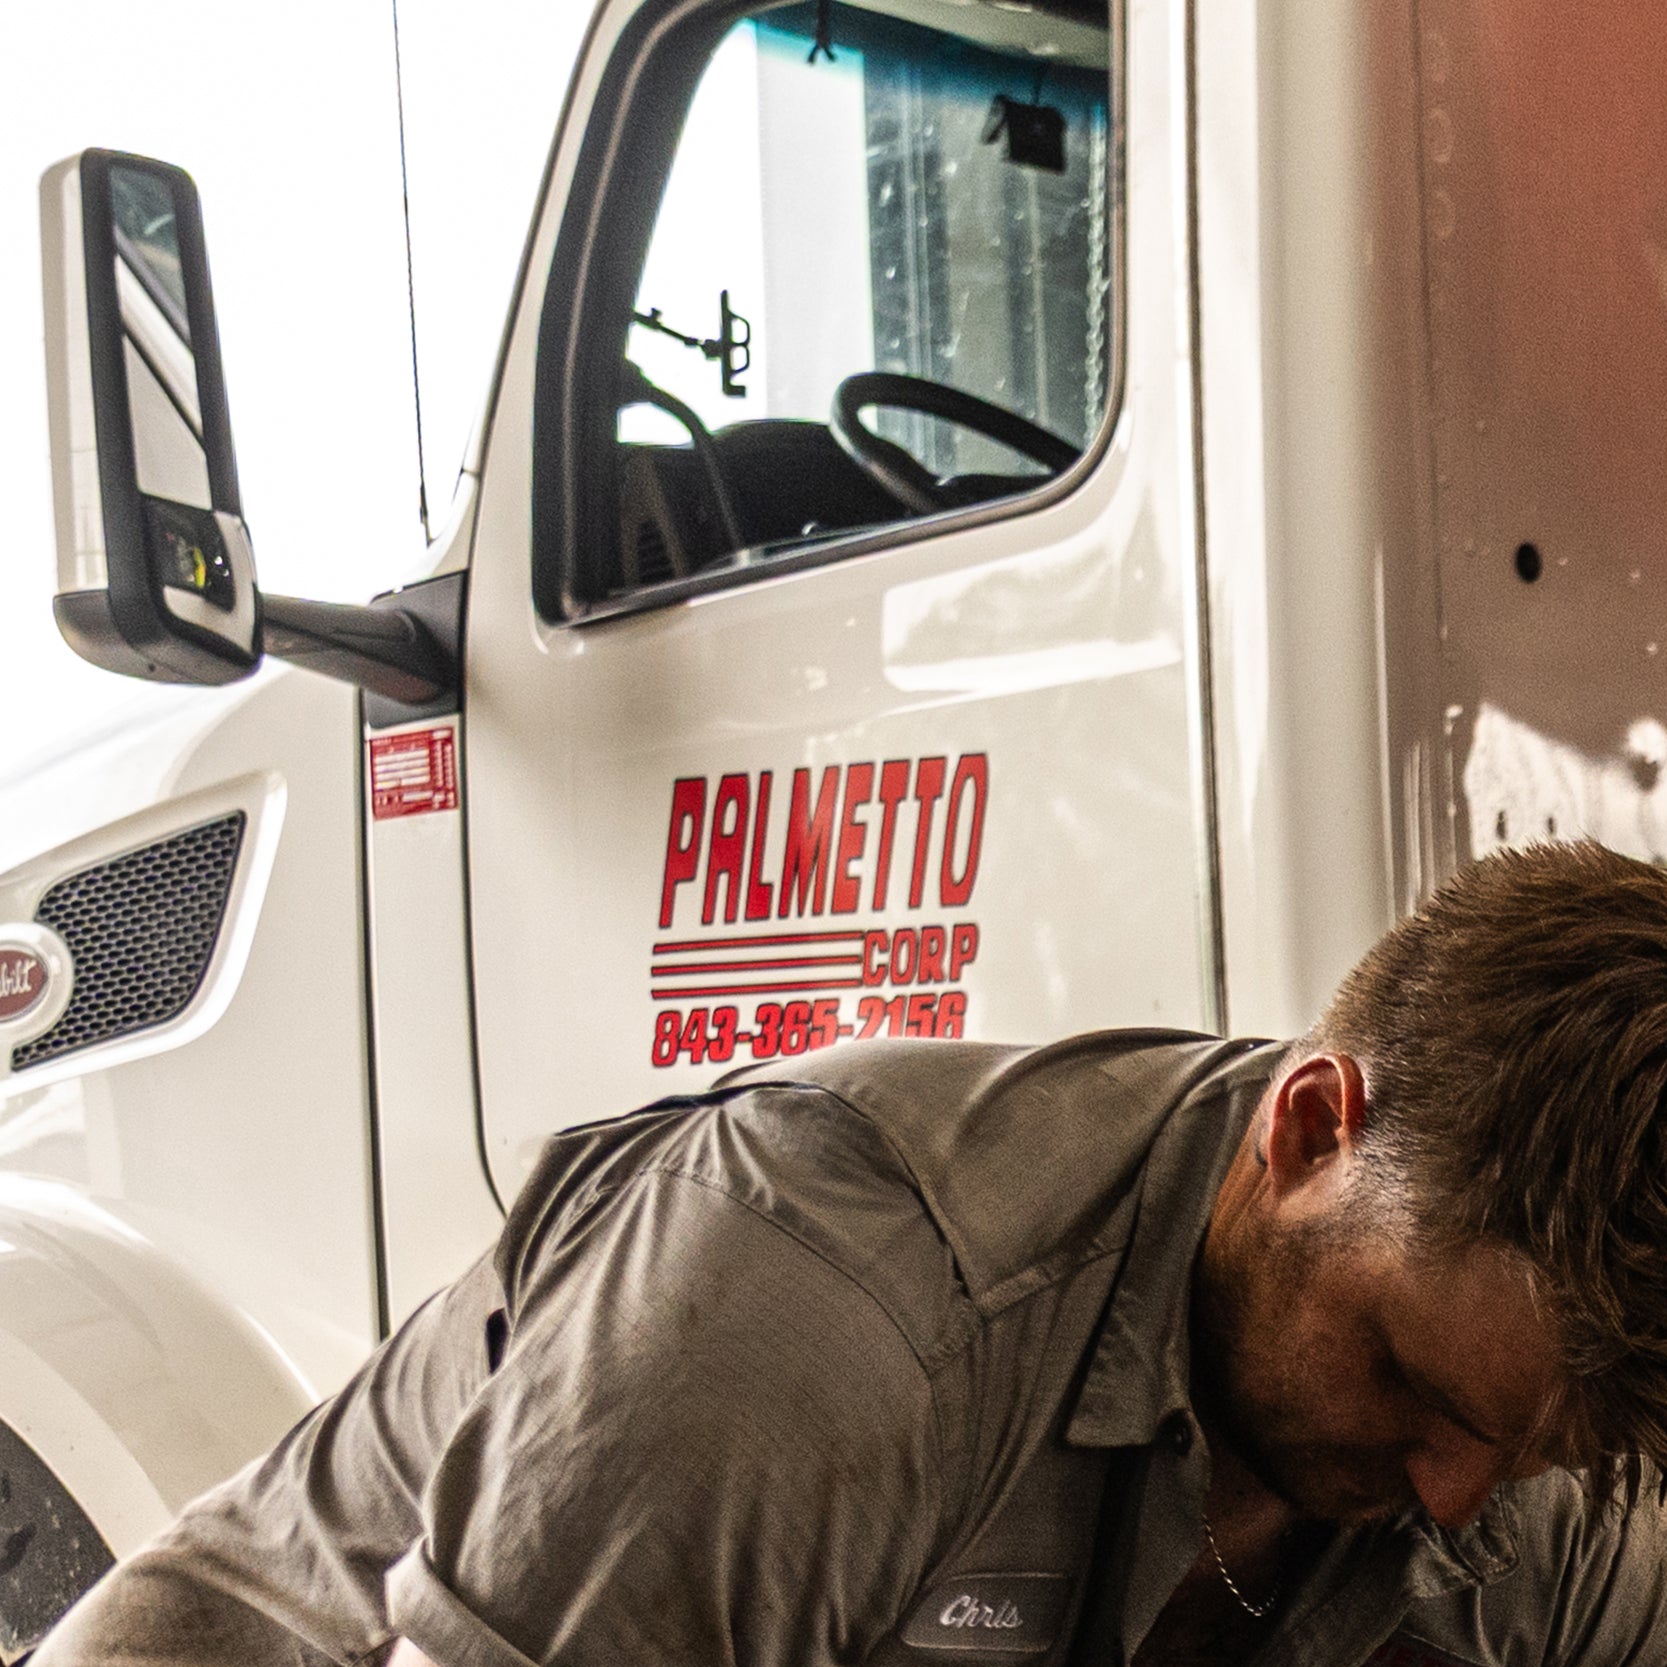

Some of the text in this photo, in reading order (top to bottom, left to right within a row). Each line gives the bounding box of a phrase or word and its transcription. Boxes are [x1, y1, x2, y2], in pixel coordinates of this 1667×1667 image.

[658, 752, 989, 929] PALMETTO
[862, 922, 980, 988] CORP
[651, 990, 968, 1068] 843-365-2156
[939, 1595, 1024, 1628] Chris
